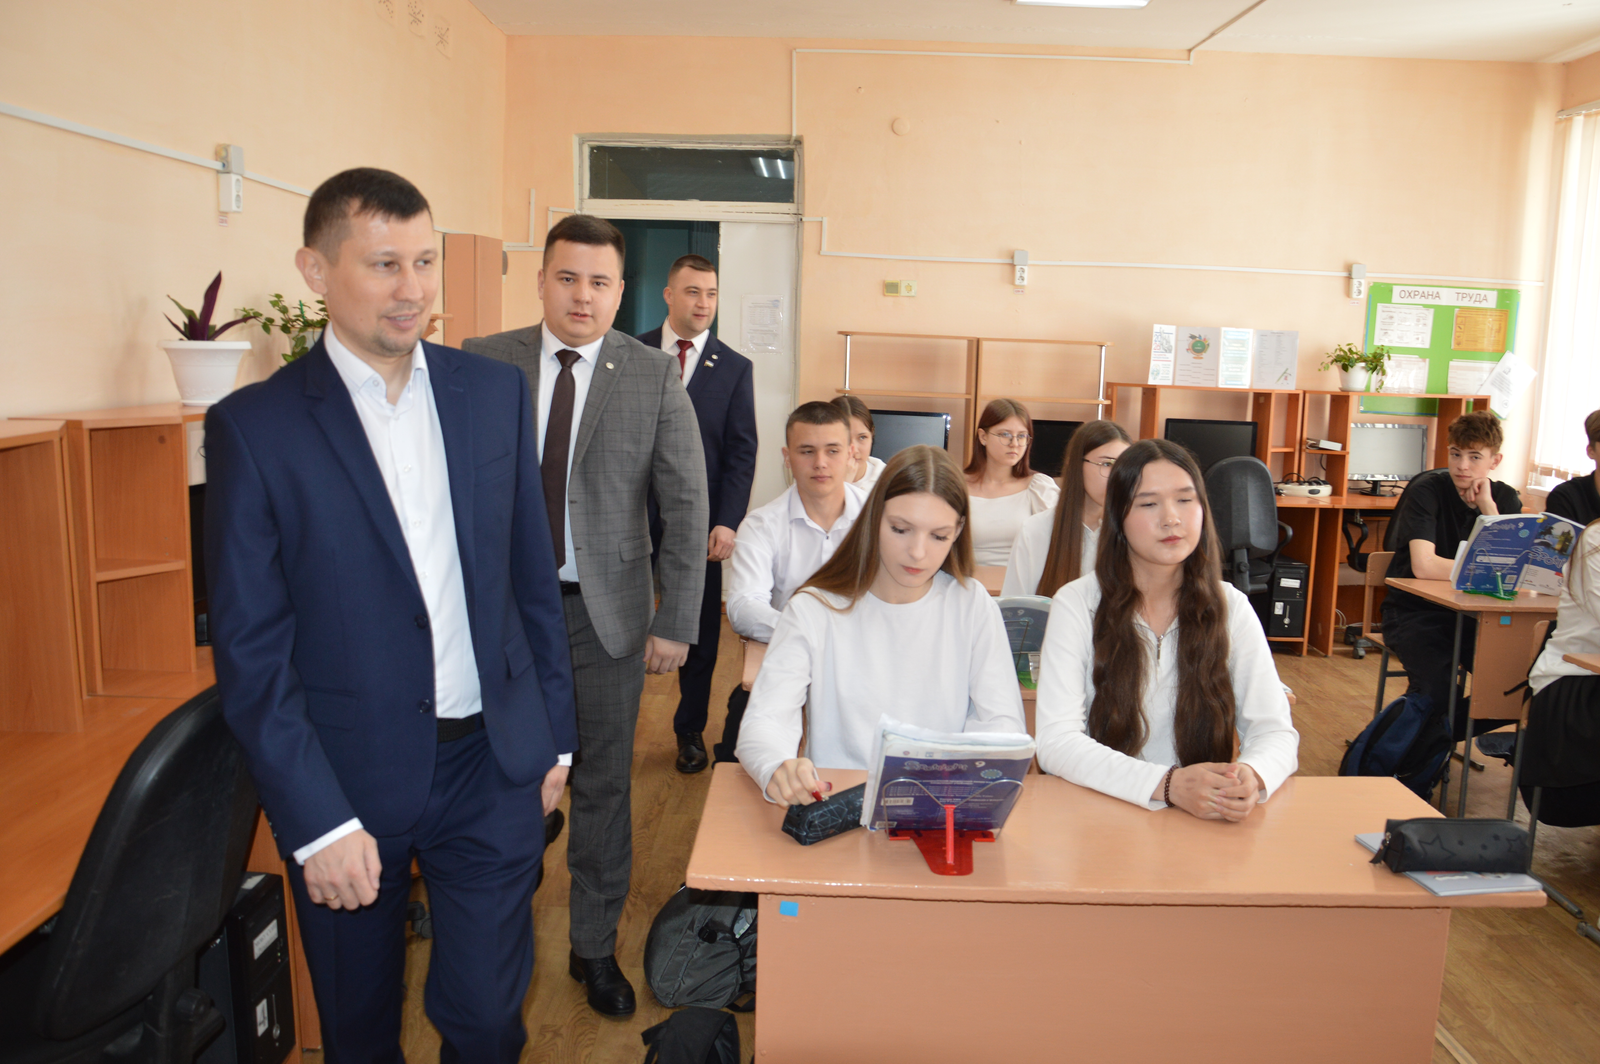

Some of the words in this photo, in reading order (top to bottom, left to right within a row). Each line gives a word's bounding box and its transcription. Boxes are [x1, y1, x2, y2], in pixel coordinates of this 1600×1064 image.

[1399, 289, 1441, 300] ОХРАНА
[1455, 291, 1488, 304] ТРУДА
[974, 760, 986, 769] 9
